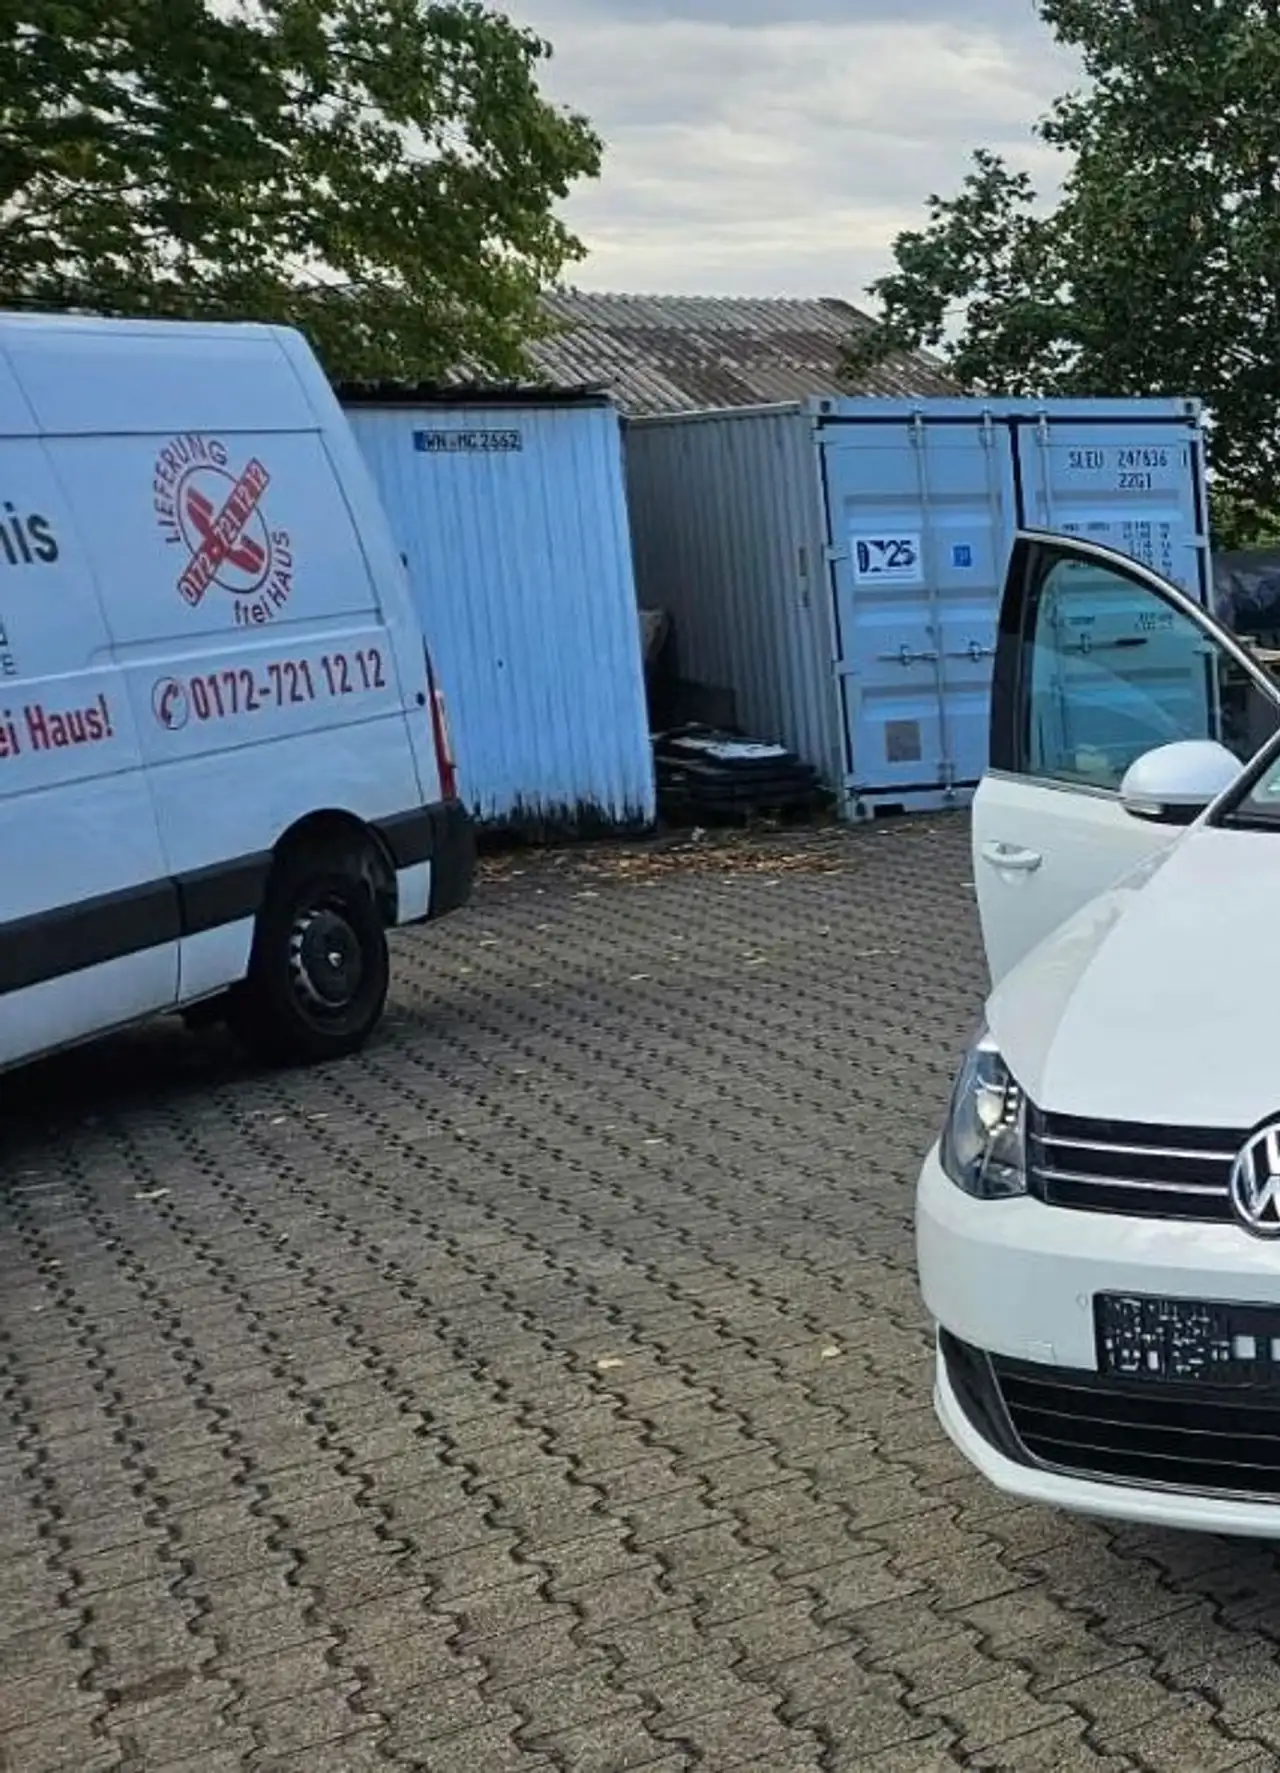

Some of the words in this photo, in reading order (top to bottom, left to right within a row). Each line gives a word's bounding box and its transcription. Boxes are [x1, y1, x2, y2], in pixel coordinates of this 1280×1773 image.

[153, 434, 228, 545] LIEFERUNG
[267, 531, 293, 608] HAUS
[189, 659, 316, 721] 0172-721
[321, 653, 353, 697] 12
[355, 647, 386, 688] 12
[23, 692, 114, 752] Haus!
